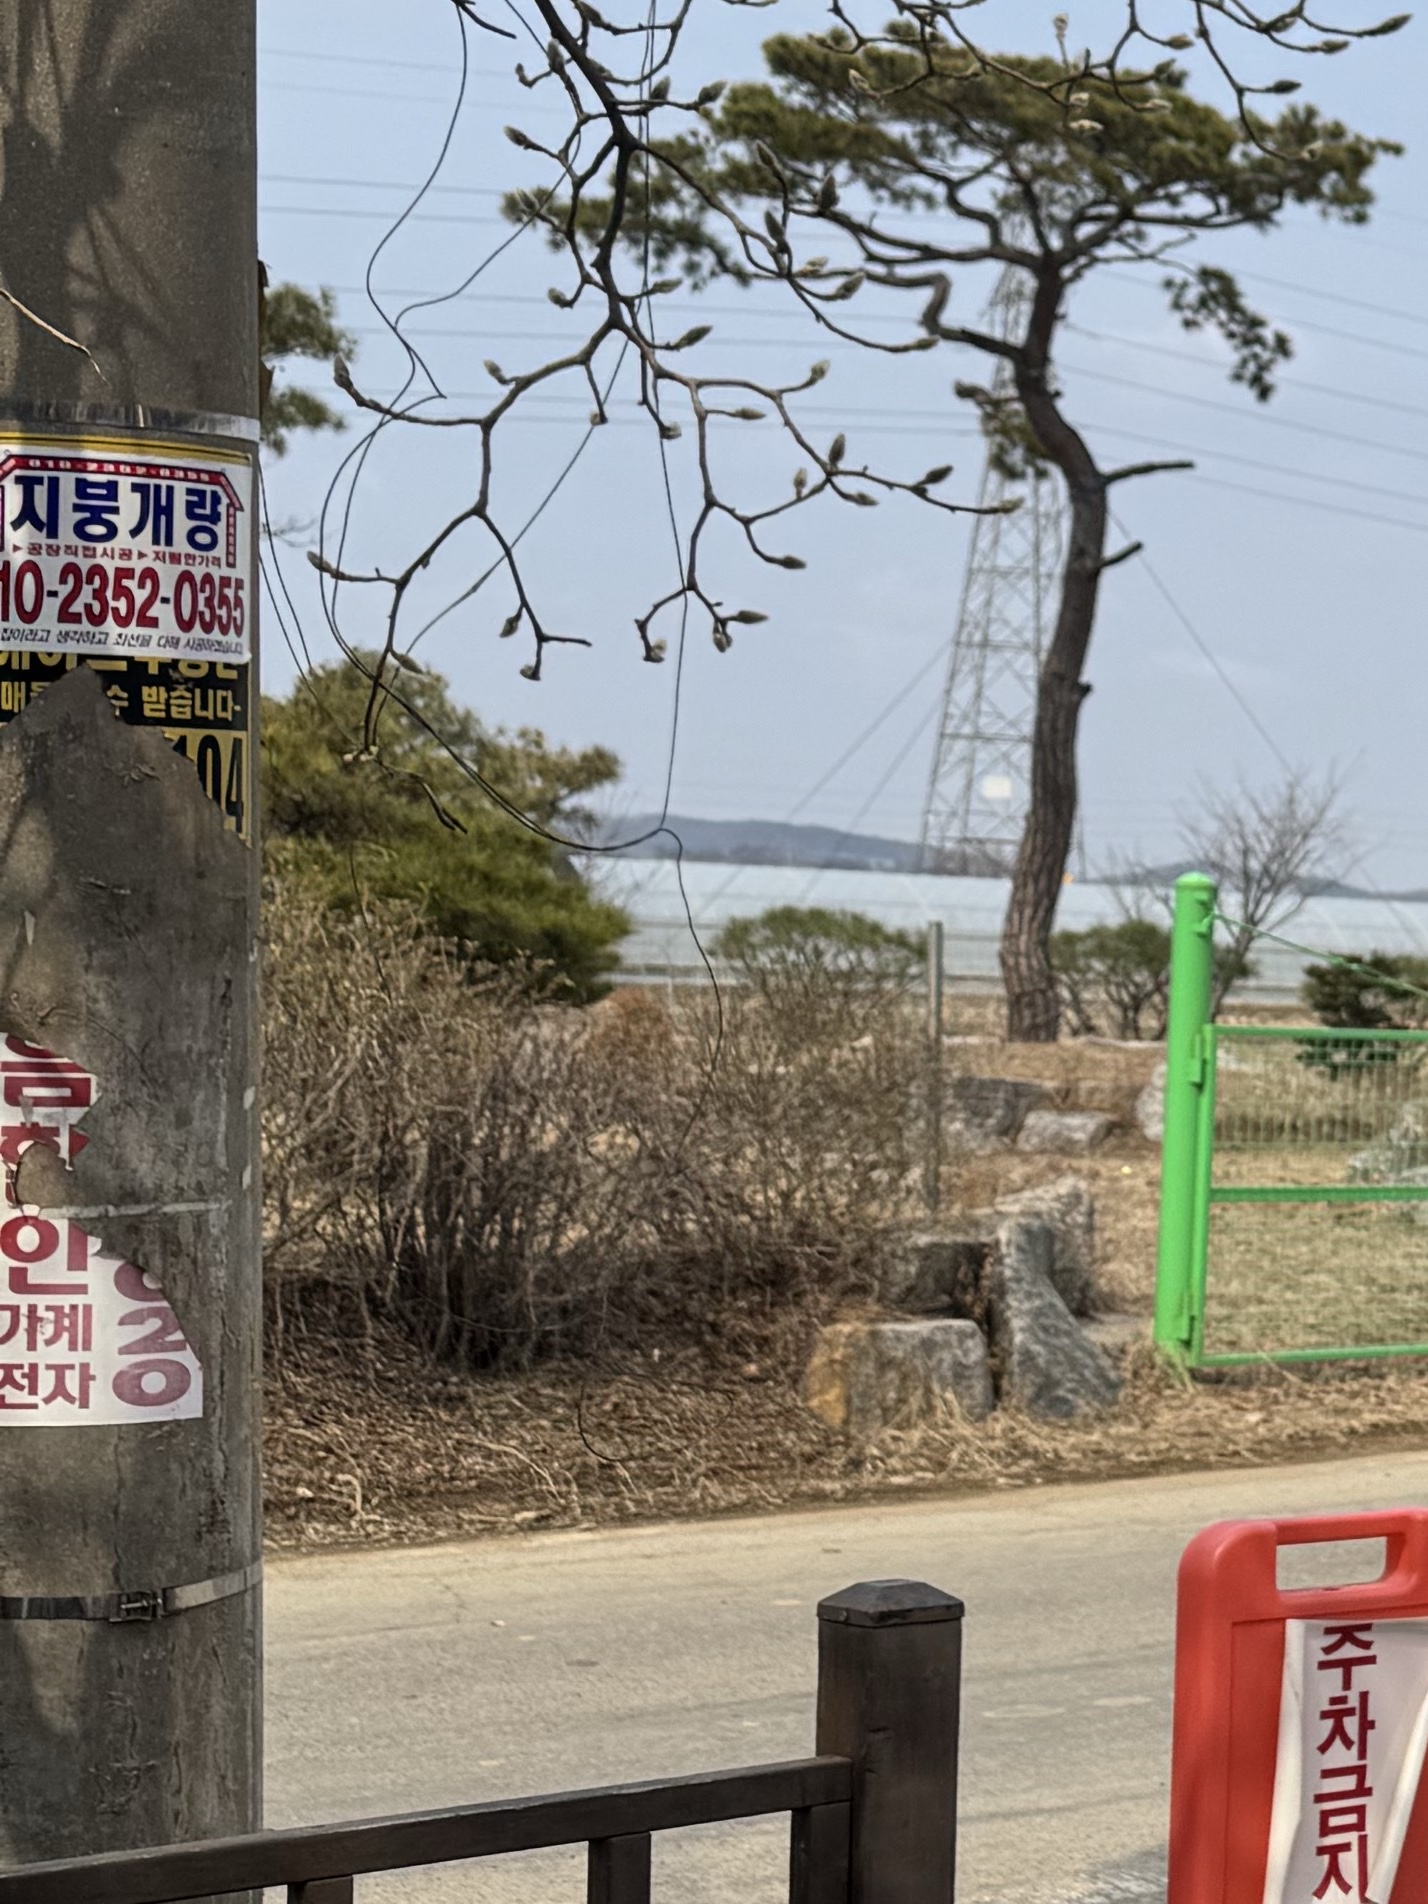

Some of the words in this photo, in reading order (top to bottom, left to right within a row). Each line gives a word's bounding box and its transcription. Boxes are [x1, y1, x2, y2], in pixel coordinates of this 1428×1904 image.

[9, 475, 222, 552] 지붕개량
[152, 550, 222, 569] 저렴한가격
[1313, 1621, 1378, 1904] 주차금지
